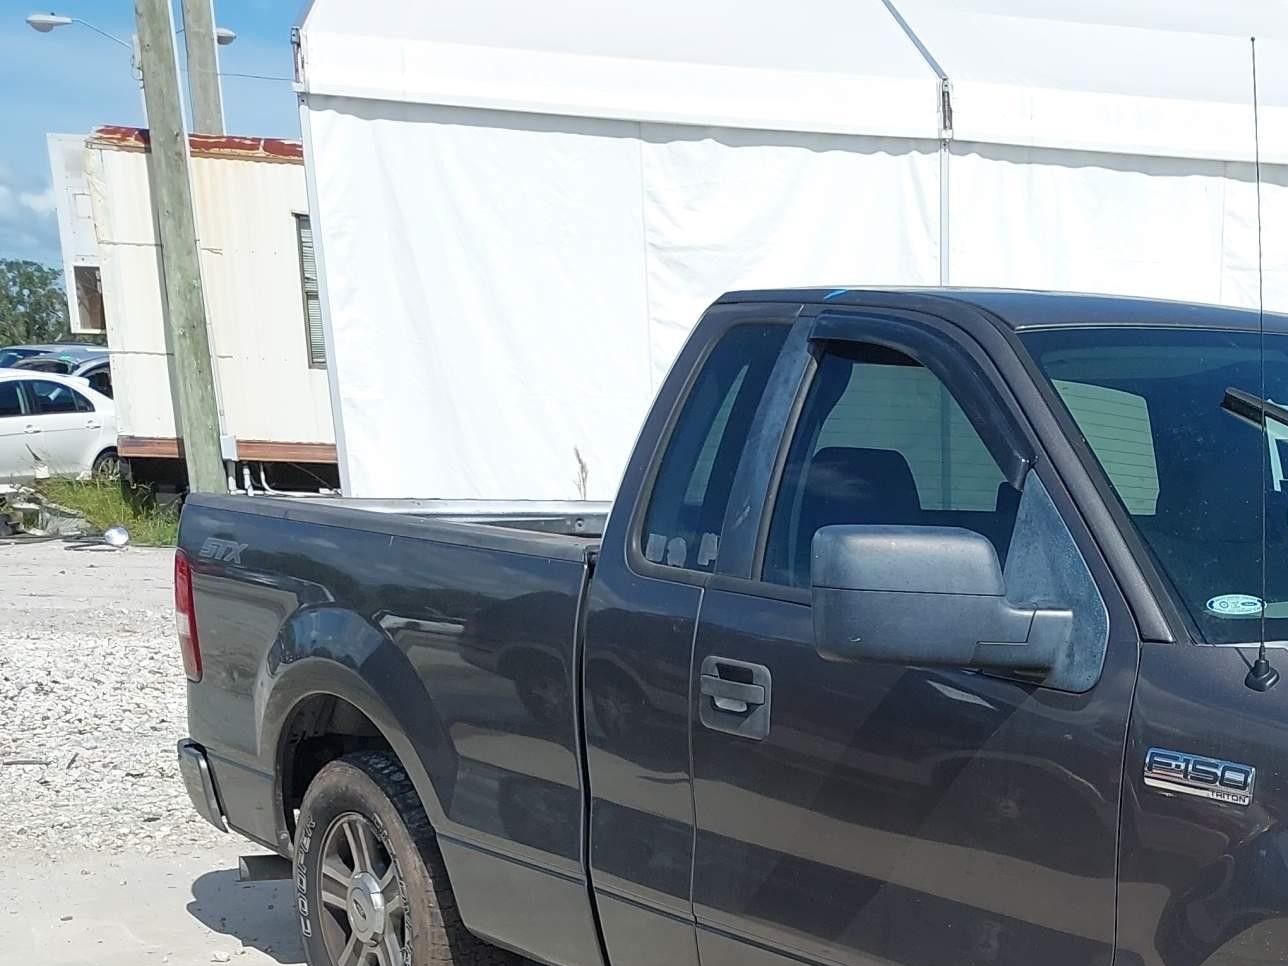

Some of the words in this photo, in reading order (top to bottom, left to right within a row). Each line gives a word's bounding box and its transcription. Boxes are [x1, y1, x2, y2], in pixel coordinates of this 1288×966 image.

[198, 536, 249, 564] STX
[1148, 752, 1250, 791] F-150
[297, 815, 317, 938] COOPER
